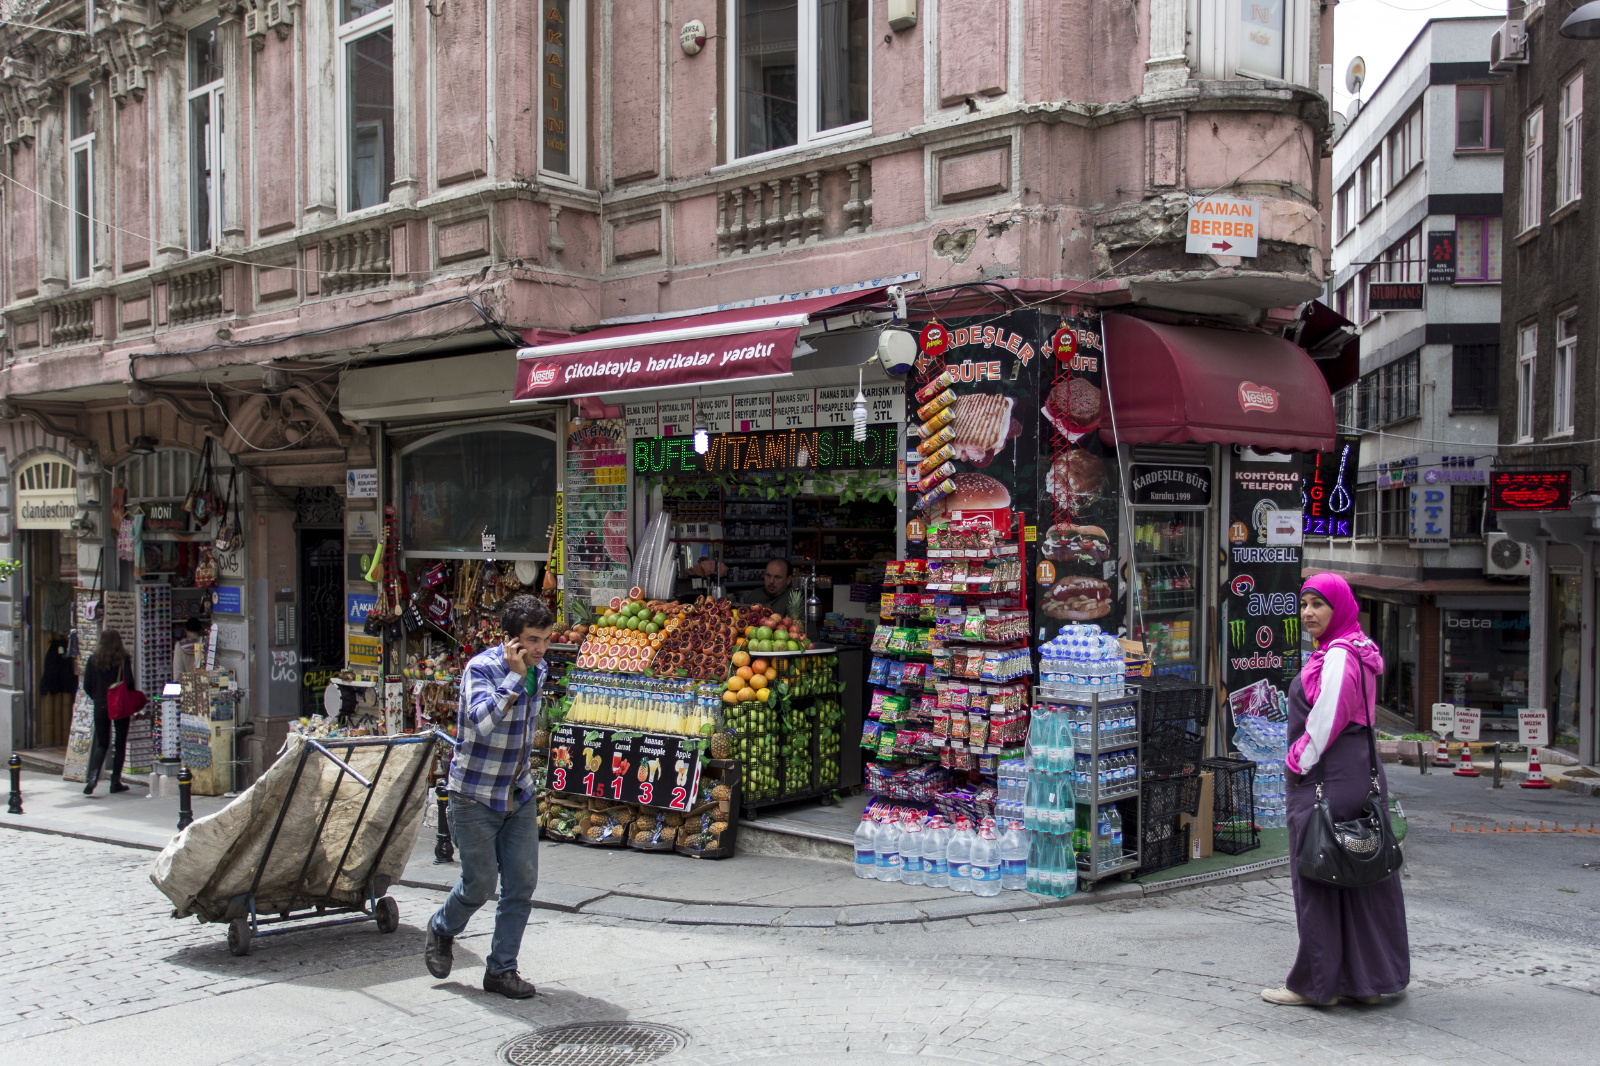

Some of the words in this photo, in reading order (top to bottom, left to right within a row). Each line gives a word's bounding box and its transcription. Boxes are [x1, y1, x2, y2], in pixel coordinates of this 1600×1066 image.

[1193, 201, 1252, 218] YAMAN
[1189, 219, 1254, 239] BERBER
[1371, 285, 1398, 300] STUDIO
[914, 325, 1035, 374] KRDEŞLER
[530, 369, 556, 386] Nestlé
[564, 358, 641, 383] Çikolatayla
[646, 351, 716, 372] harikalar
[719, 341, 775, 367] yaratır
[946, 359, 1001, 383] BÜFE
[820, 390, 840, 400] ANANAS
[861, 387, 891, 398] KARIŞIK
[892, 384, 906, 395] MİX
[775, 394, 796, 404] ANANAS
[1241, 388, 1275, 408] Nestlé
[627, 407, 640, 415] ELMA
[642, 405, 656, 414] SUYU
[696, 401, 714, 411] HAVUÇ
[714, 399, 729, 408] SUYU
[774, 406, 801, 416] PINEAPPLE
[800, 404, 814, 414] JUICE
[872, 400, 893, 410] ATOM
[714, 411, 731, 420] JUICE
[758, 408, 772, 418] JUICE
[829, 412, 846, 422] 1TL
[874, 410, 892, 421] 3TL
[640, 416, 658, 426] JUICE
[786, 415, 803, 426] 3TL
[569, 422, 622, 444] VİTAMİN
[635, 427, 648, 436] 2TL
[634, 435, 696, 472] BÜFE
[703, 428, 819, 472] VİTAMİN
[818, 428, 899, 466] SHOP
[1133, 469, 1184, 491] KARDEŞLER
[1185, 472, 1209, 493] BÜFE
[1235, 471, 1299, 482] KONTÖRLÜ
[1438, 470, 1486, 483] YAMAHA
[1240, 482, 1293, 491] TELEFON
[1150, 491, 1175, 503] Kuruluş
[1176, 492, 1191, 501] 1999
[22, 500, 75, 519] clandestino
[150, 503, 172, 520] MONİ
[1424, 490, 1445, 534] DTL
[910, 522, 923, 535] TL
[1233, 524, 1245, 537] TL
[1232, 547, 1299, 563] TURKCELL
[1039, 563, 1053, 577] TL
[1248, 592, 1298, 617] avea
[1447, 617, 1492, 628] beta
[1528, 726, 1538, 734] EVİ
[553, 735, 576, 745] Atom-mix
[644, 736, 664, 746] Ananas
[615, 743, 631, 752] Carrot
[639, 746, 666, 757] Pineapple
[675, 750, 692, 759] Apple
[552, 767, 567, 790] 3
[611, 775, 624, 800] 1
[638, 782, 653, 805] 3
[670, 786, 687, 810] 2
